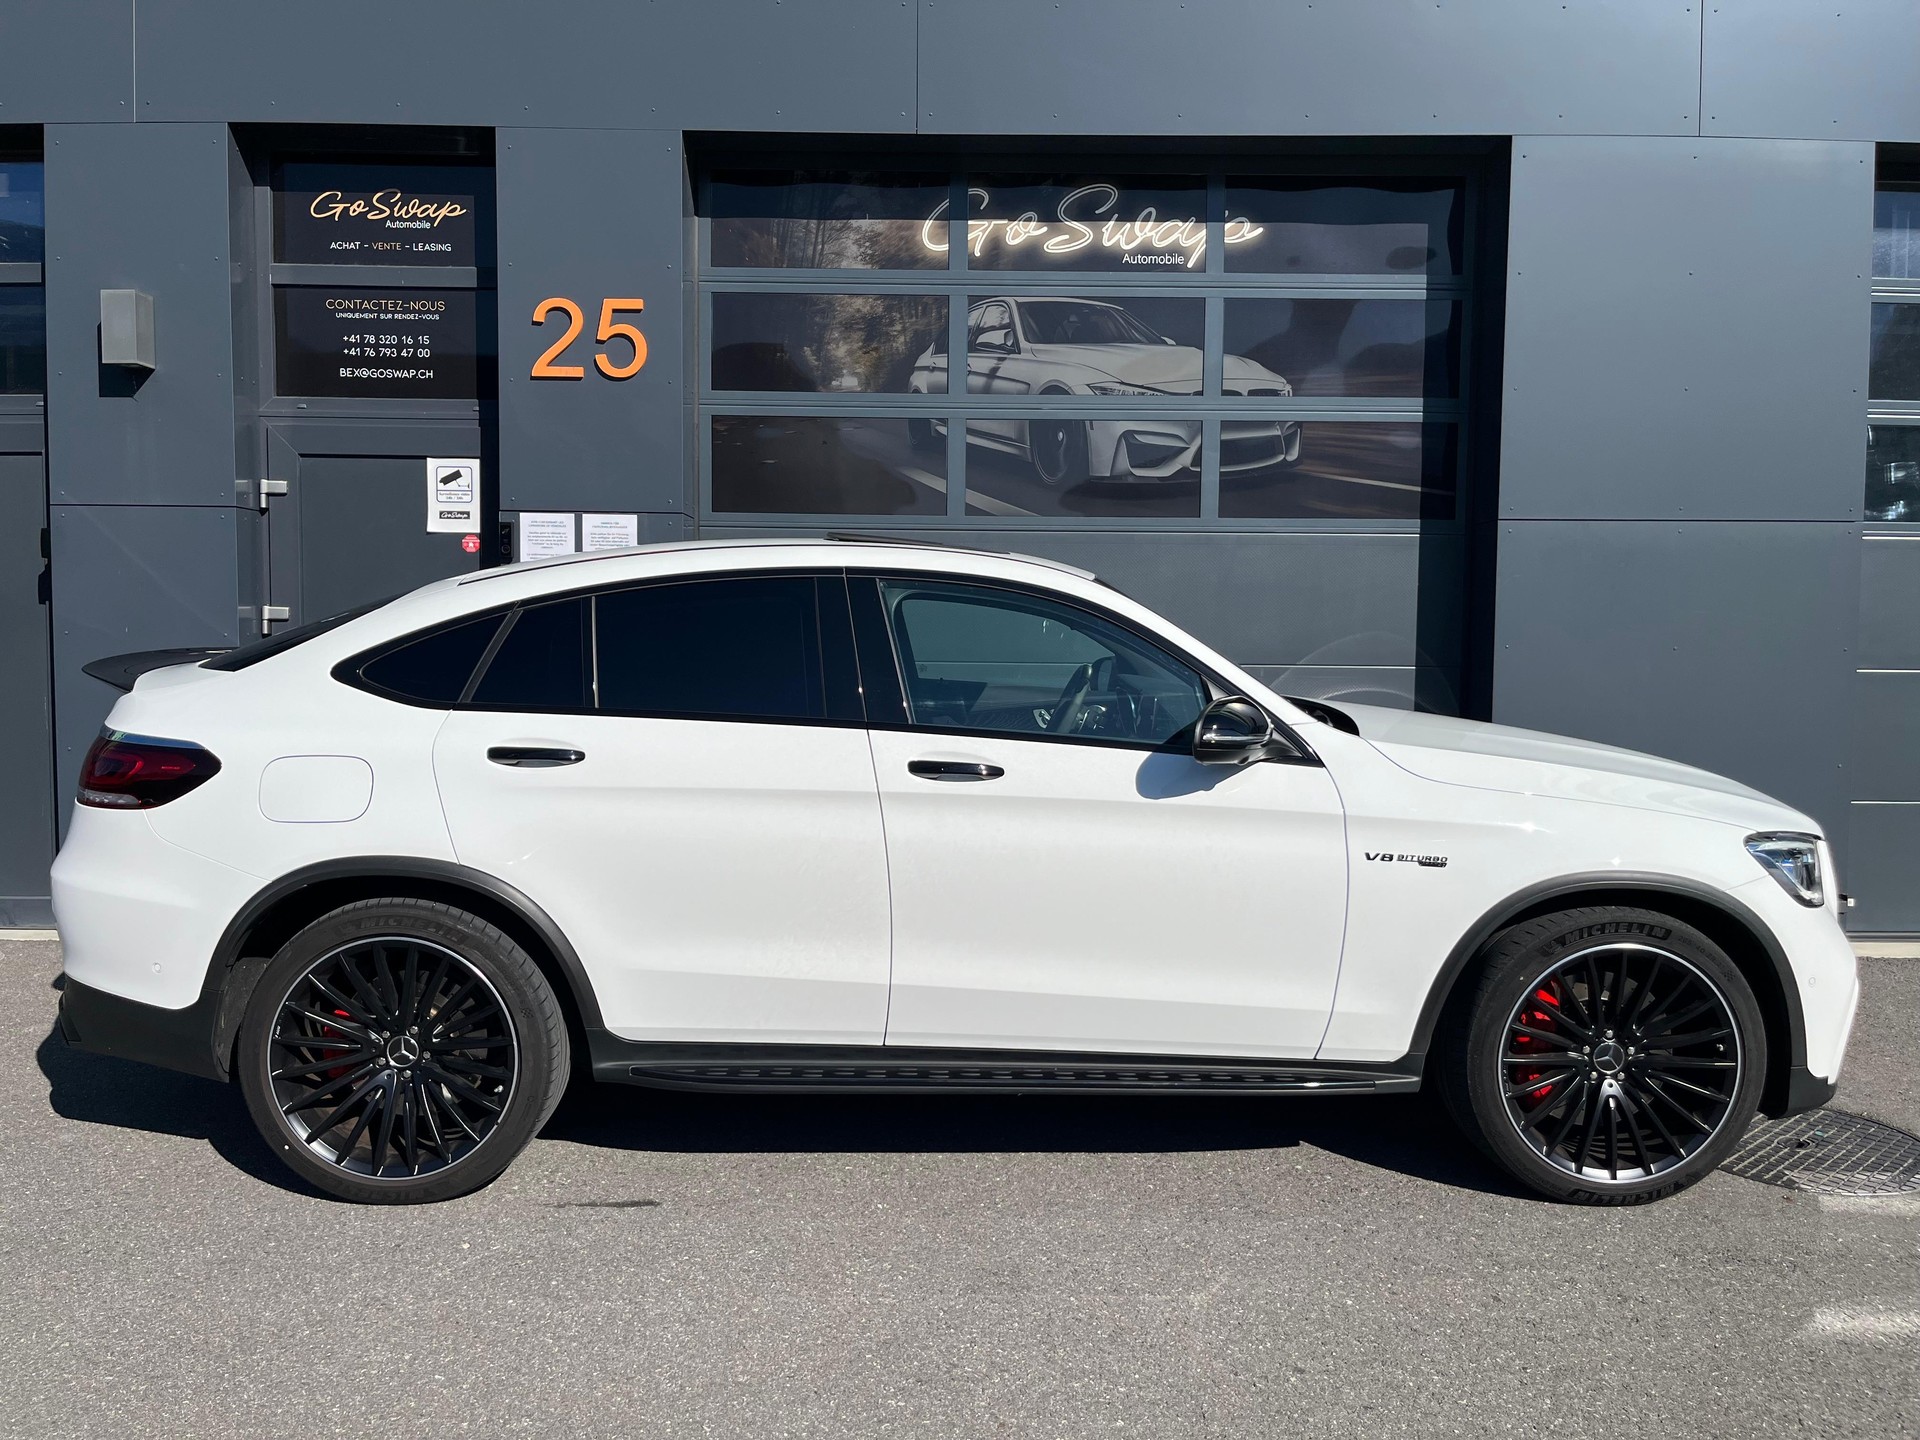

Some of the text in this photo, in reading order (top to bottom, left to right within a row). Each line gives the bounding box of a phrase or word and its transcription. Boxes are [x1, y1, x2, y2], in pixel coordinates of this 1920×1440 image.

[385, 219, 431, 229] Automobile
[330, 241, 361, 250] ACHAT
[371, 242, 402, 251] VENTE
[412, 243, 452, 251] LEASING
[1122, 253, 1185, 266] Automobile
[325, 299, 446, 311] CONTACTEZ-NOUS
[343, 334, 430, 345] +41 78 320 16 15
[531, 297, 648, 379] 25
[343, 347, 431, 358] +41 76 793 47 00
[339, 367, 434, 379] BEX@GOSWAP.CH
[1364, 852, 1448, 863] V8 BITURBO
[1564, 922, 1667, 945] MICHELIN
